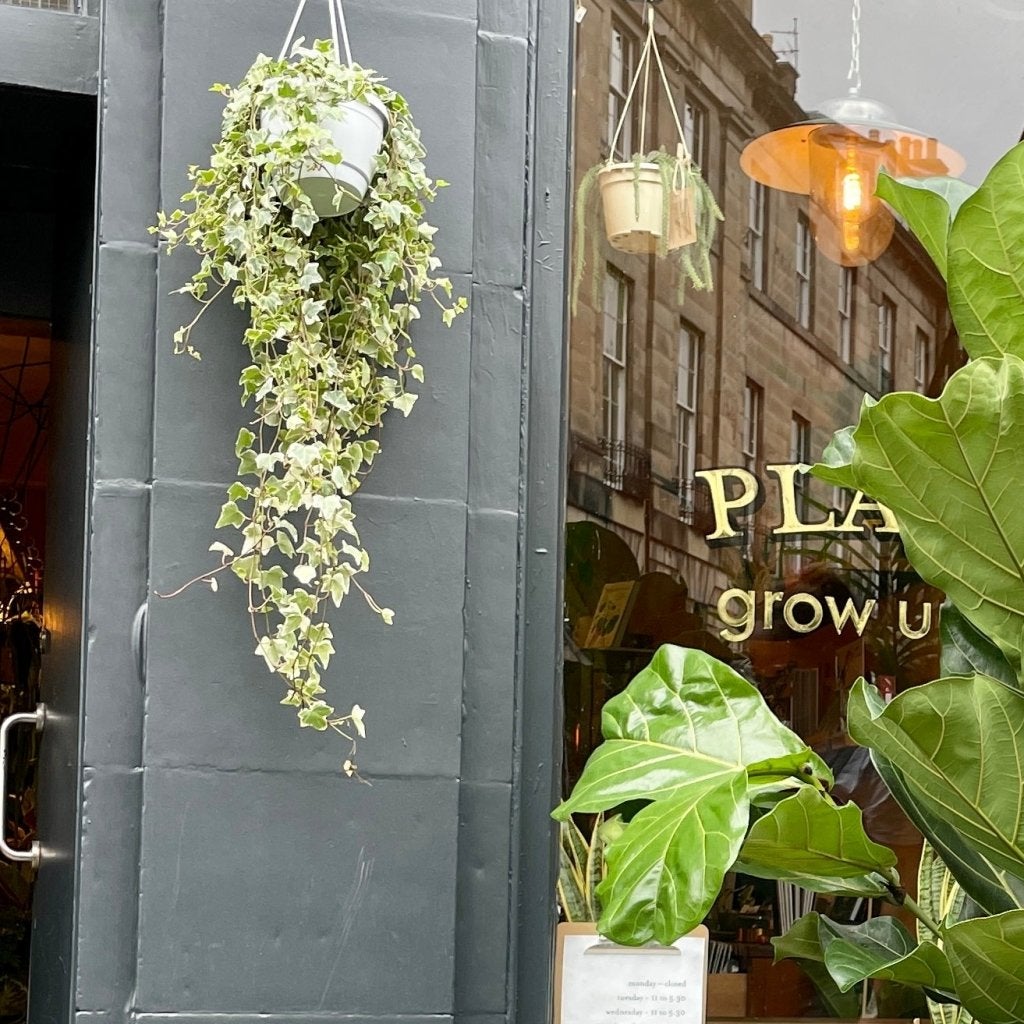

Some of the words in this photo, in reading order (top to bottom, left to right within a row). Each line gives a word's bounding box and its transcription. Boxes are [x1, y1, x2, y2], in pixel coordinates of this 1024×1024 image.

[695, 463, 900, 541] PLA
[717, 588, 876, 642] grow
[899, 600, 932, 640] u
[628, 980, 656, 989] monday
[664, 979, 686, 987] closed
[617, 994, 643, 1002] tuesday
[669, 995, 686, 1003] 5.30
[606, 1008, 643, 1017] wednesday
[668, 1010, 685, 1018] 5.30
